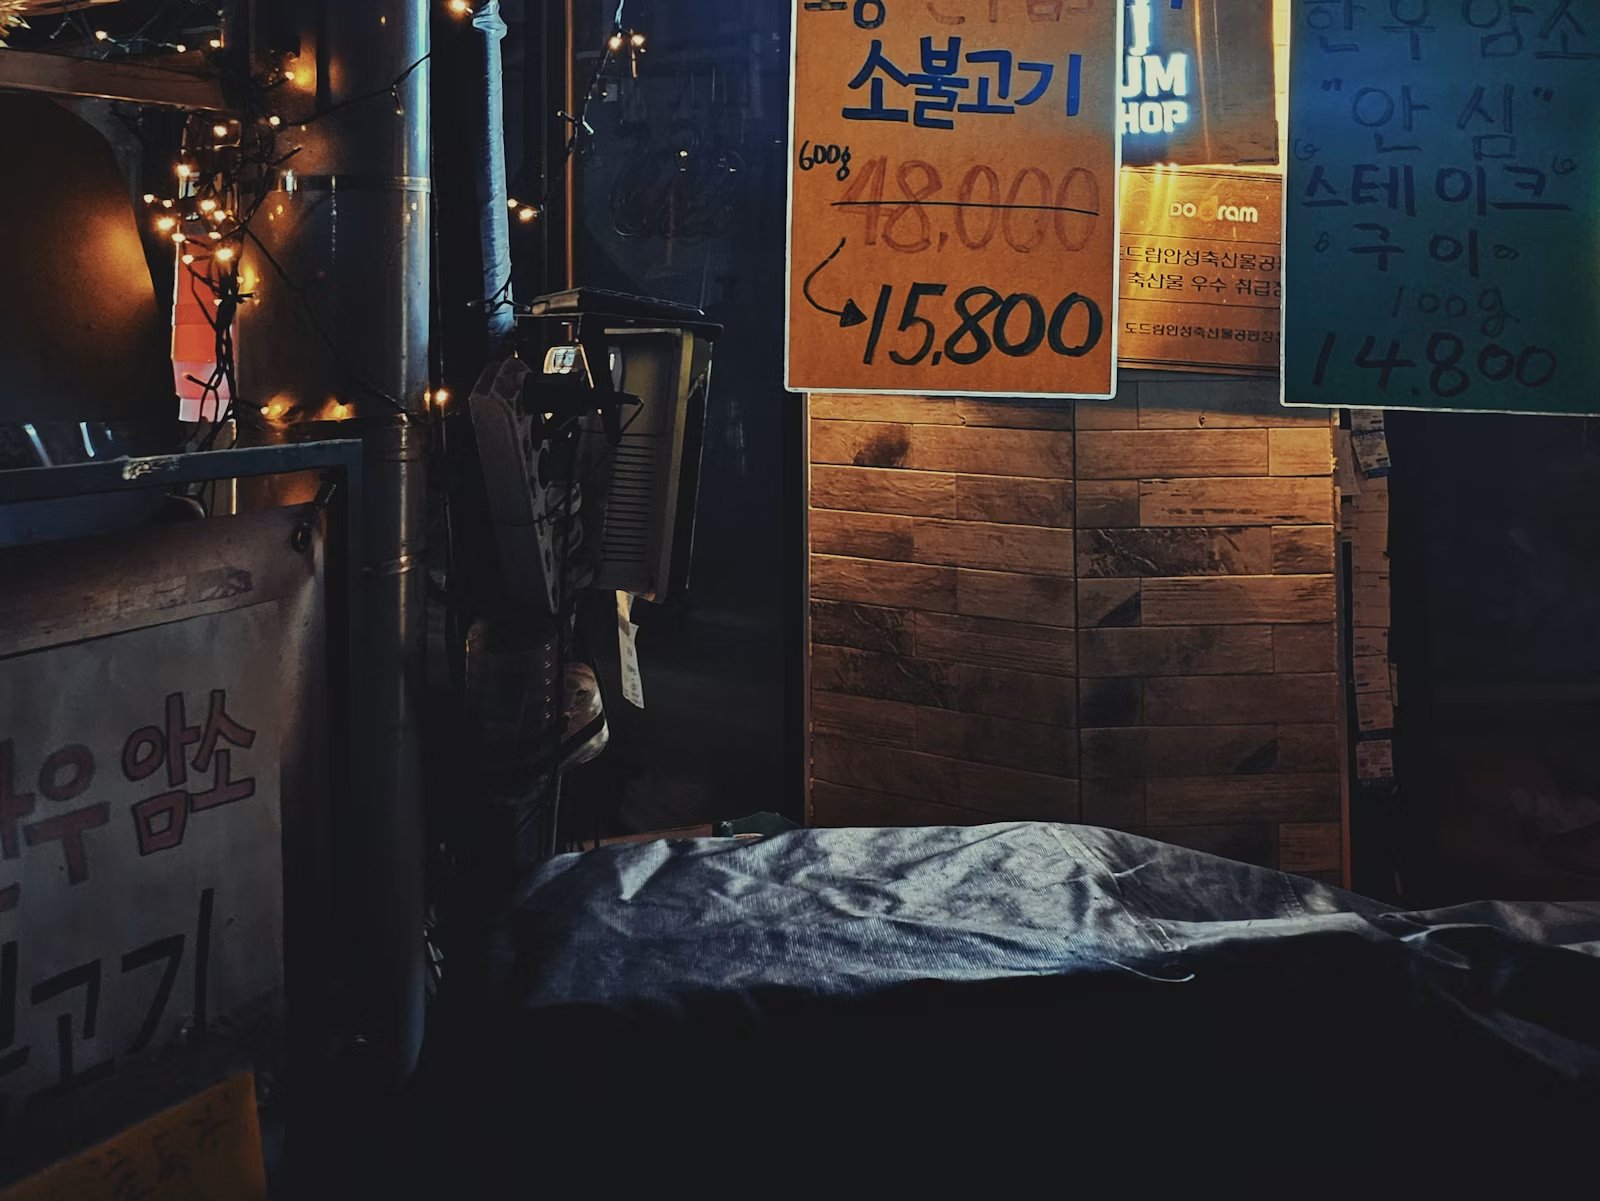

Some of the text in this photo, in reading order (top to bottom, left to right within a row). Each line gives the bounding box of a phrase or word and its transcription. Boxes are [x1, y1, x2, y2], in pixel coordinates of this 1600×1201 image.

[841, 35, 1082, 130] 소불고기
[799, 140, 852, 182] 600g
[1301, 163, 1573, 219] 스테이크
[1120, 245, 1281, 272] 드람안성축산물공
[1348, 222, 1479, 278] 구이
[1128, 271, 1184, 291] 축산물
[1191, 275, 1227, 294] 우수
[1392, 287, 1519, 337] 100g
